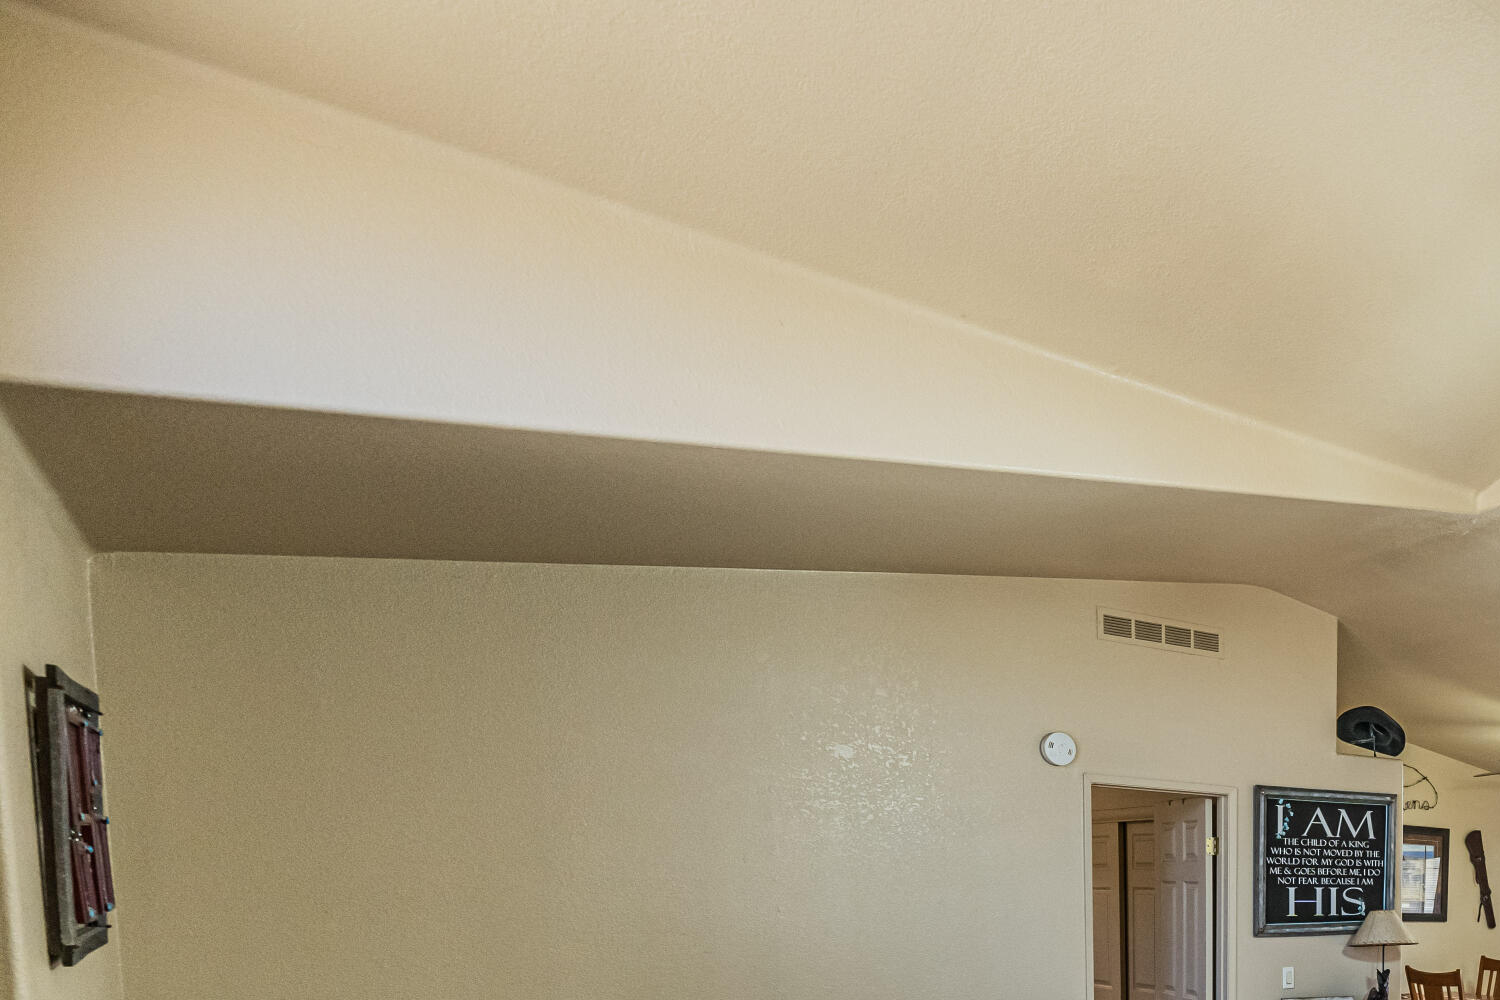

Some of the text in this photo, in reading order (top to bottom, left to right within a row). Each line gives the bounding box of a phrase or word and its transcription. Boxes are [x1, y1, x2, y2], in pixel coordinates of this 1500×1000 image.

[1301, 807, 1376, 839] AM
[1283, 838, 1299, 846] THE
[1301, 838, 1327, 847] CHILD
[1341, 840, 1348, 848] A
[1349, 840, 1370, 849] KING
[1270, 847, 1381, 858] WHO IS NOT MOVED BY THE
[1266, 857, 1384, 868] WORLD FOR MY GOD IS WITH
[1269, 867, 1282, 875] ME
[1284, 867, 1292, 875] &
[1294, 867, 1316, 875] GOES
[1318, 868, 1348, 876] BEFORE
[1367, 869, 1381, 877] DO
[1277, 877, 1296, 885] NOT
[1298, 877, 1319, 885] FEAR
[1321, 877, 1355, 885] BECAUSE
[1361, 878, 1374, 886] AM
[1286, 886, 1366, 917] HIS
